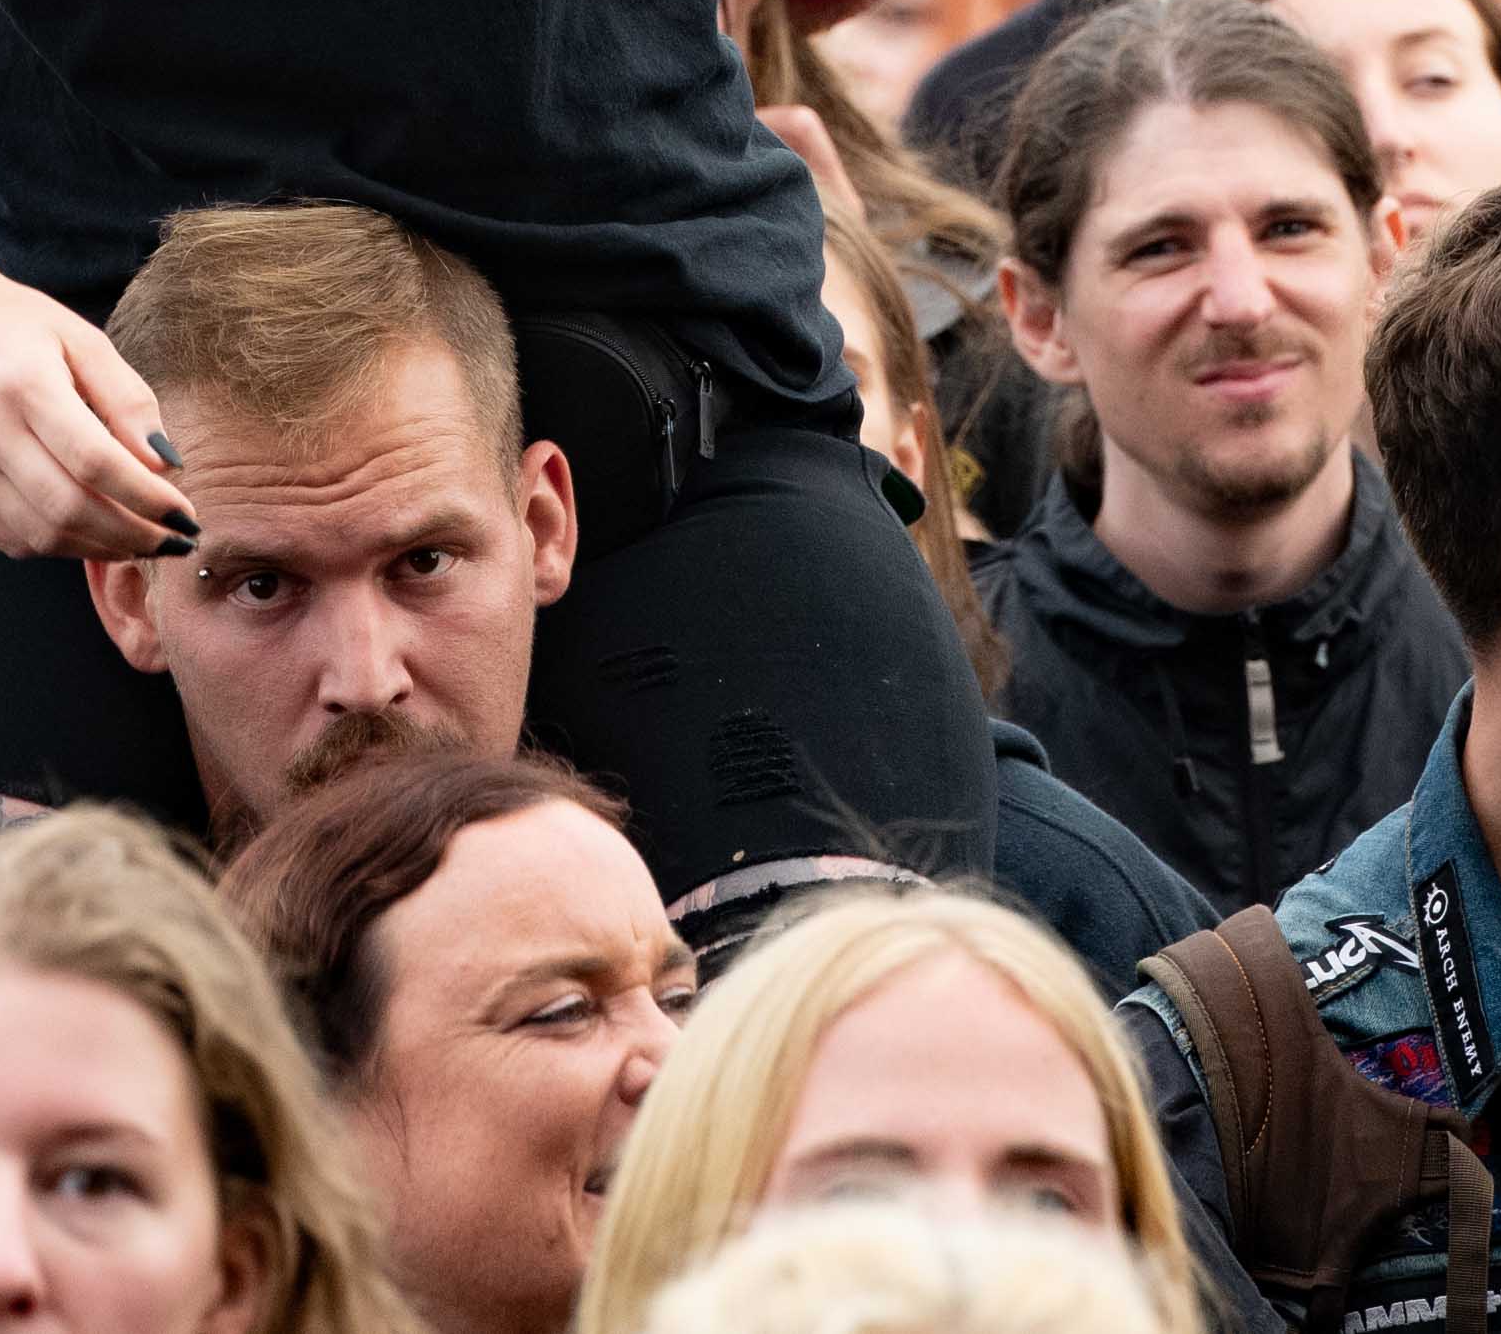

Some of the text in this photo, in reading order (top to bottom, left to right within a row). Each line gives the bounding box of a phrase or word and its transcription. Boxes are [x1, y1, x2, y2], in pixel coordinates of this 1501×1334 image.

[1303, 919, 1420, 991] LICA
[1435, 928, 1483, 1077] ARCH ENEMY
